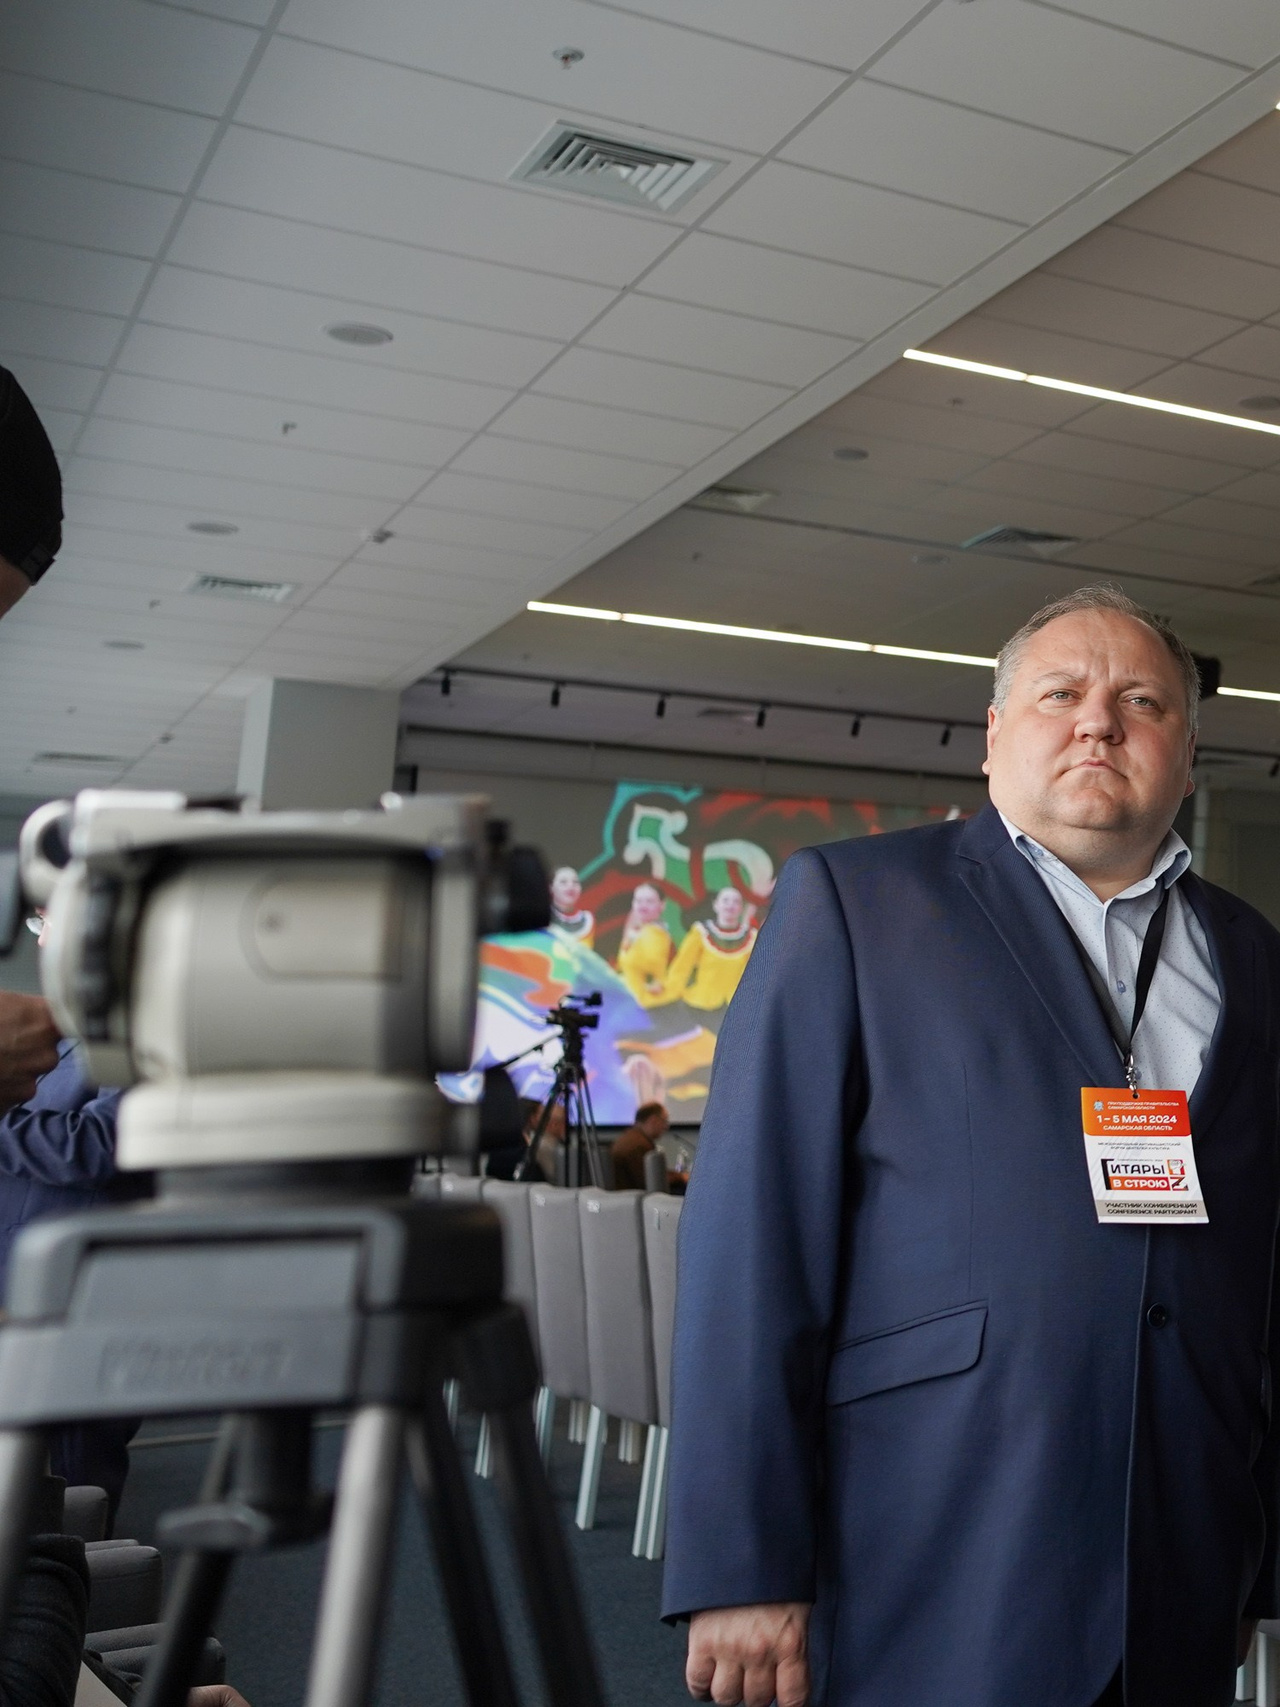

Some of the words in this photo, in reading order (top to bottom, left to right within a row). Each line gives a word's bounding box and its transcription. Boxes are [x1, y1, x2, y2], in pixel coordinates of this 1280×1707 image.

[1121, 1115, 1148, 1124] МАЯ
[1148, 1115, 1178, 1124] 2024
[1112, 1179, 1122, 1188] В
[1123, 1179, 1168, 1189] СТРОЮ
